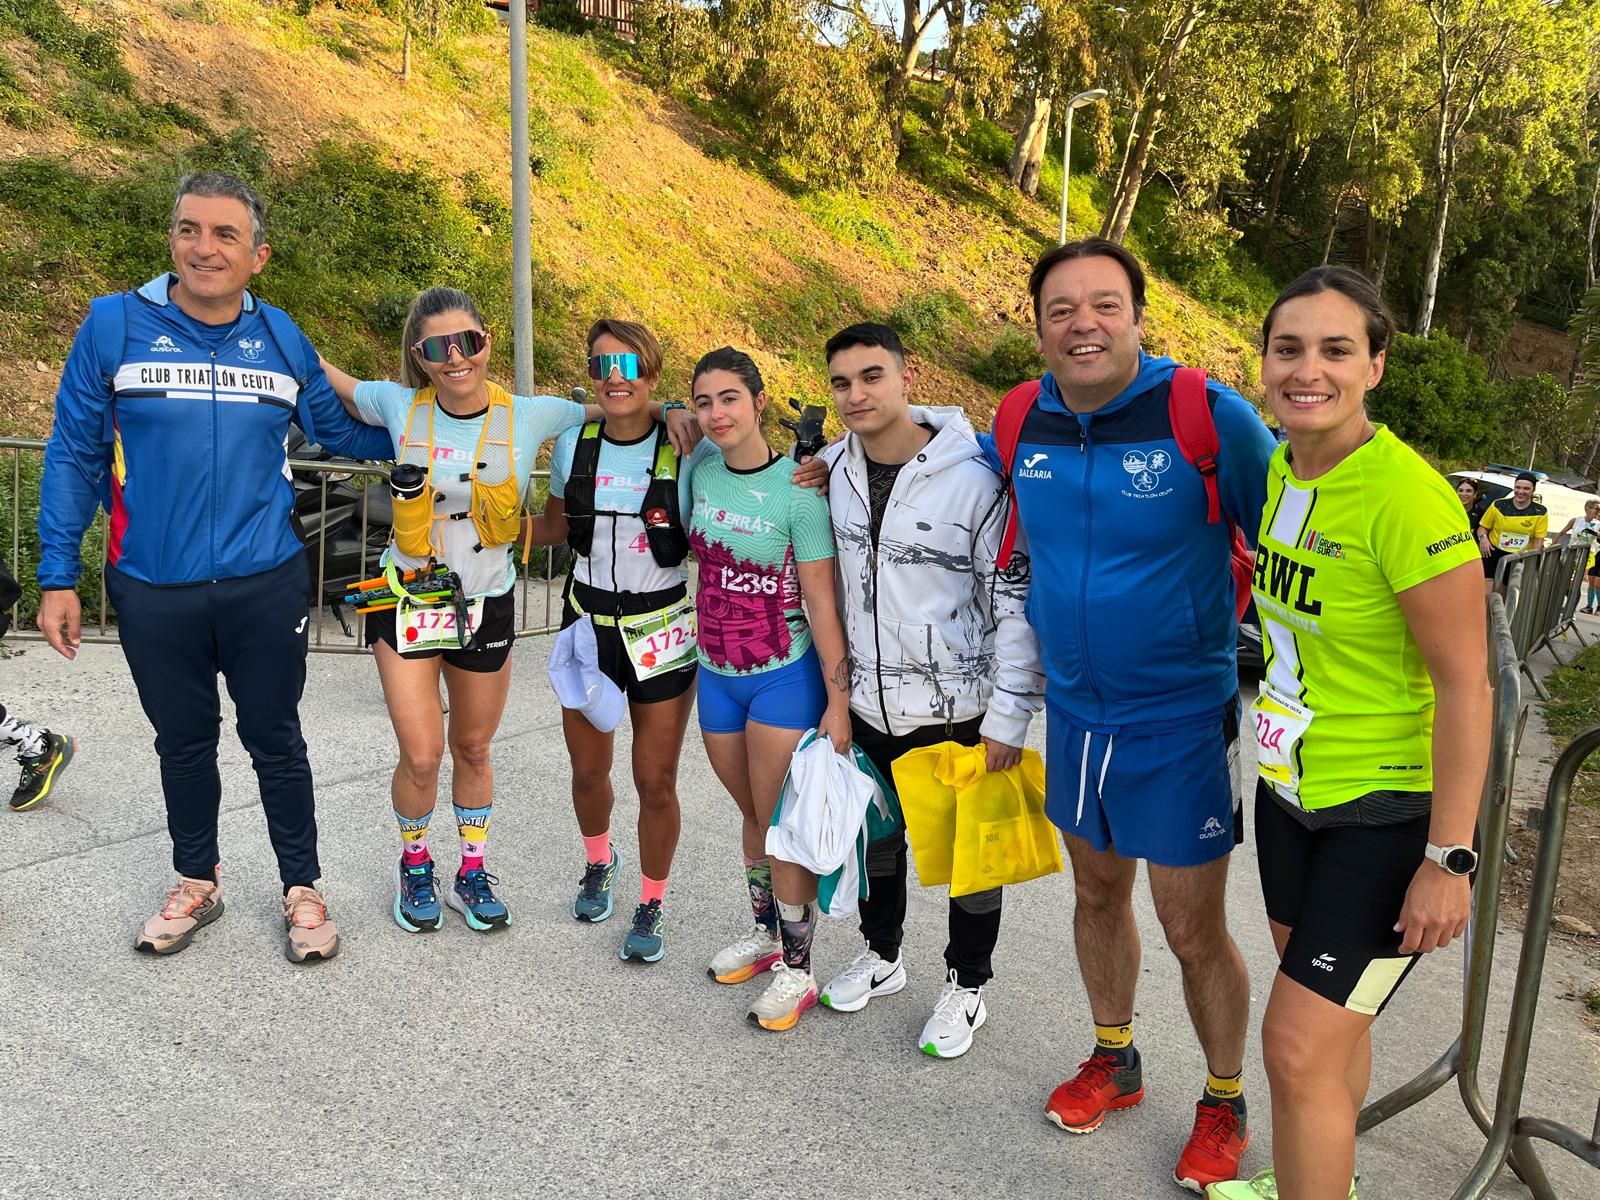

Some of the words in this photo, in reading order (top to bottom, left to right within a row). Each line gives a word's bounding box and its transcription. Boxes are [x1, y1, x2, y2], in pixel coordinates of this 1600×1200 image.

[141, 368, 171, 384] CLUB
[177, 368, 236, 387] TRIATLÓN
[242, 373, 275, 392] CEUTA
[1019, 468, 1052, 480] BALEARIA
[1318, 538, 1342, 550] GRUPO
[1317, 547, 1346, 560] SURBCN
[720, 565, 778, 595] 1236
[416, 612, 475, 630] 1721
